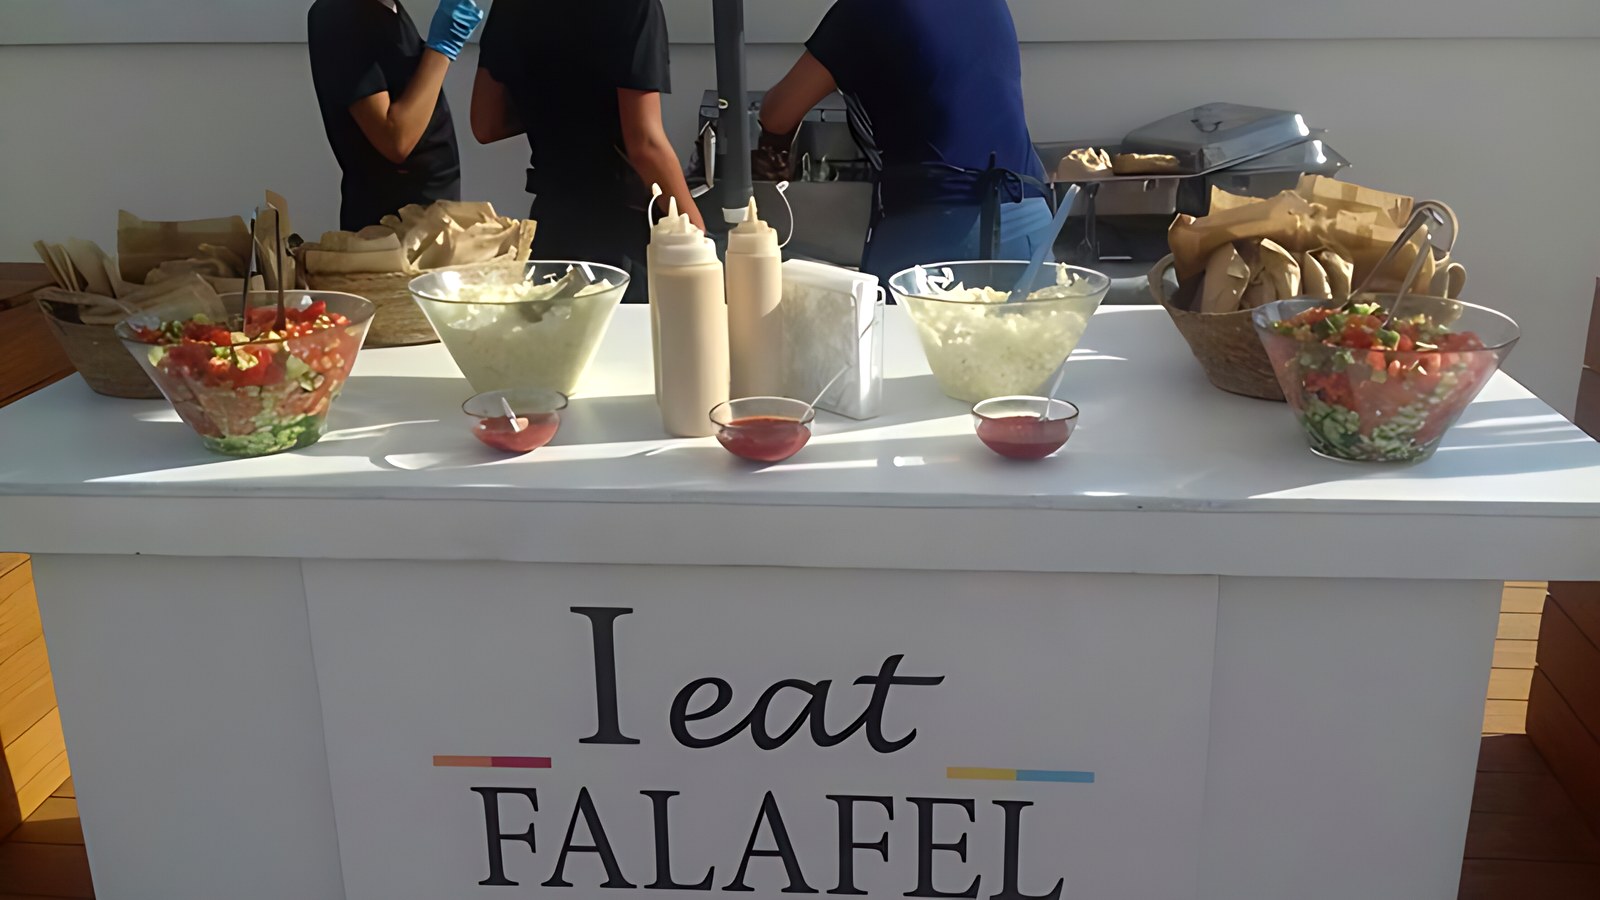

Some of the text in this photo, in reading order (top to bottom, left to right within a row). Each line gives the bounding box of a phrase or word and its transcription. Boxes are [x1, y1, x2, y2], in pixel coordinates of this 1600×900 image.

[570, 607, 945, 753] I eat
[470, 786, 1064, 900] FALAFEL
